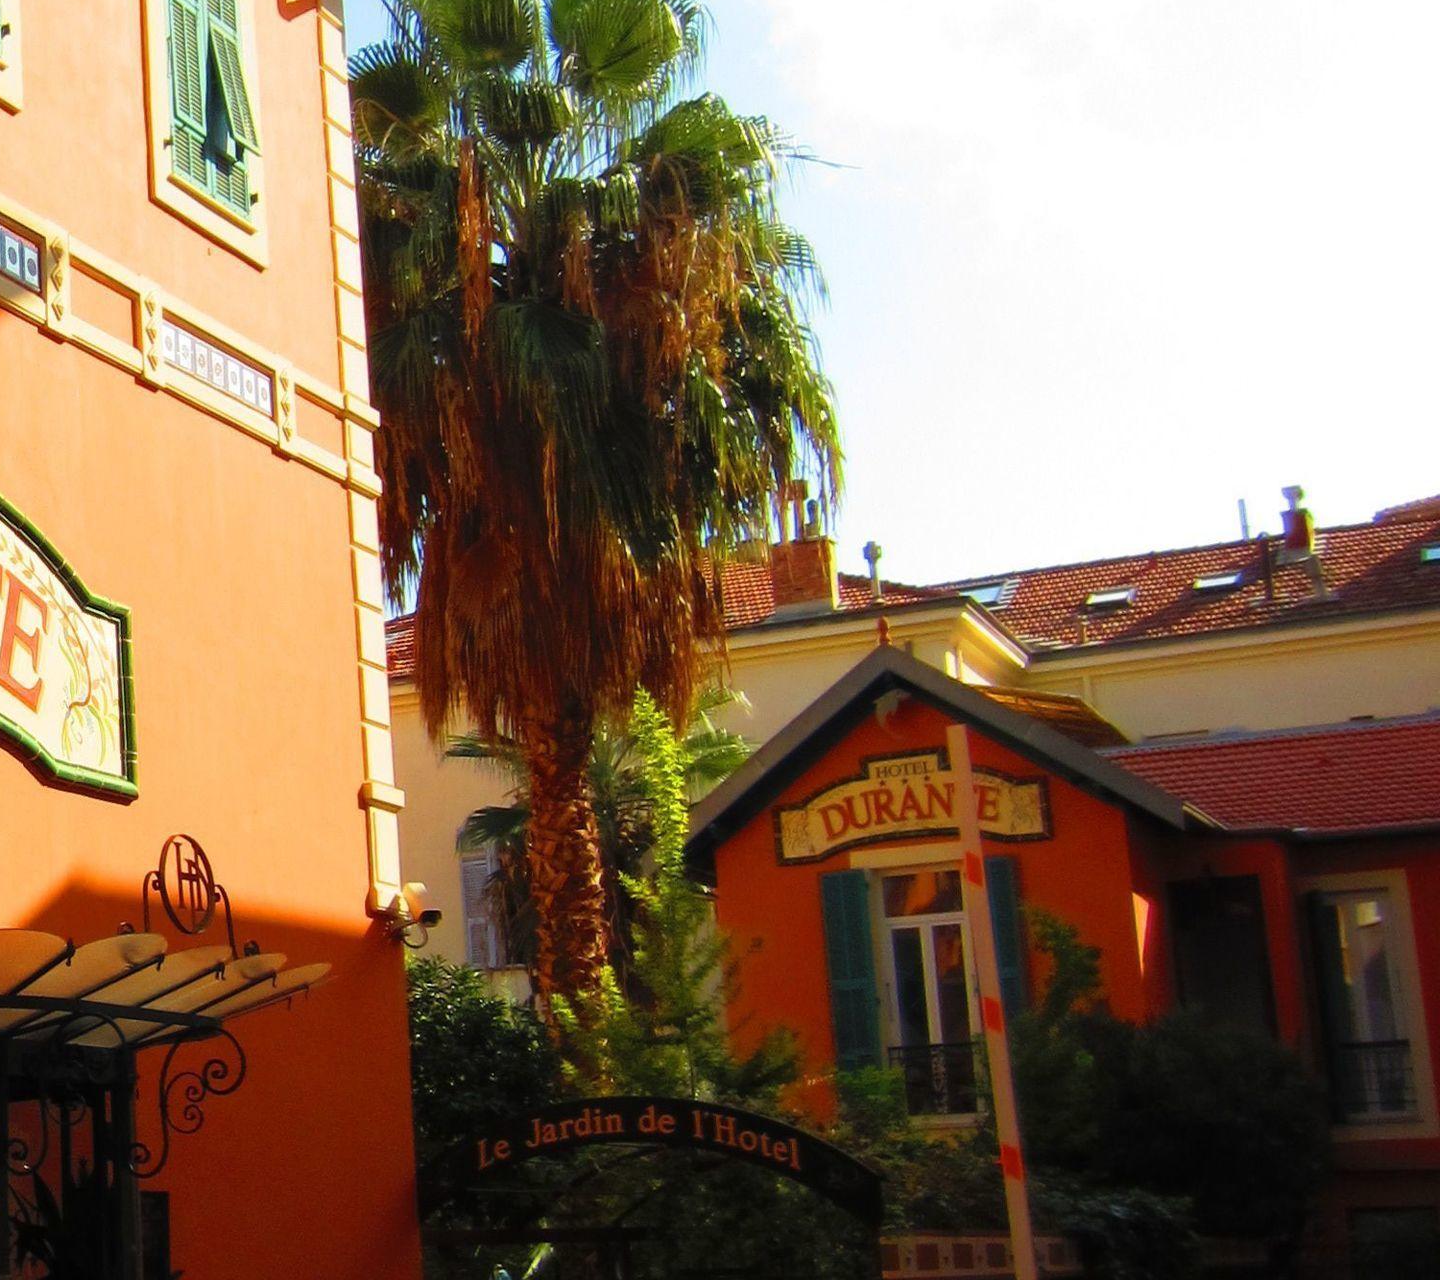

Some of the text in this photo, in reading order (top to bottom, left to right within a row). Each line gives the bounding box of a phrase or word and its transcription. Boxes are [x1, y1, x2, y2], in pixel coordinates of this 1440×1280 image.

[875, 760, 930, 779] HOTEL
[818, 783, 1000, 841] DURANE
[477, 1104, 802, 1171] Le Jardin de l'Hotel
